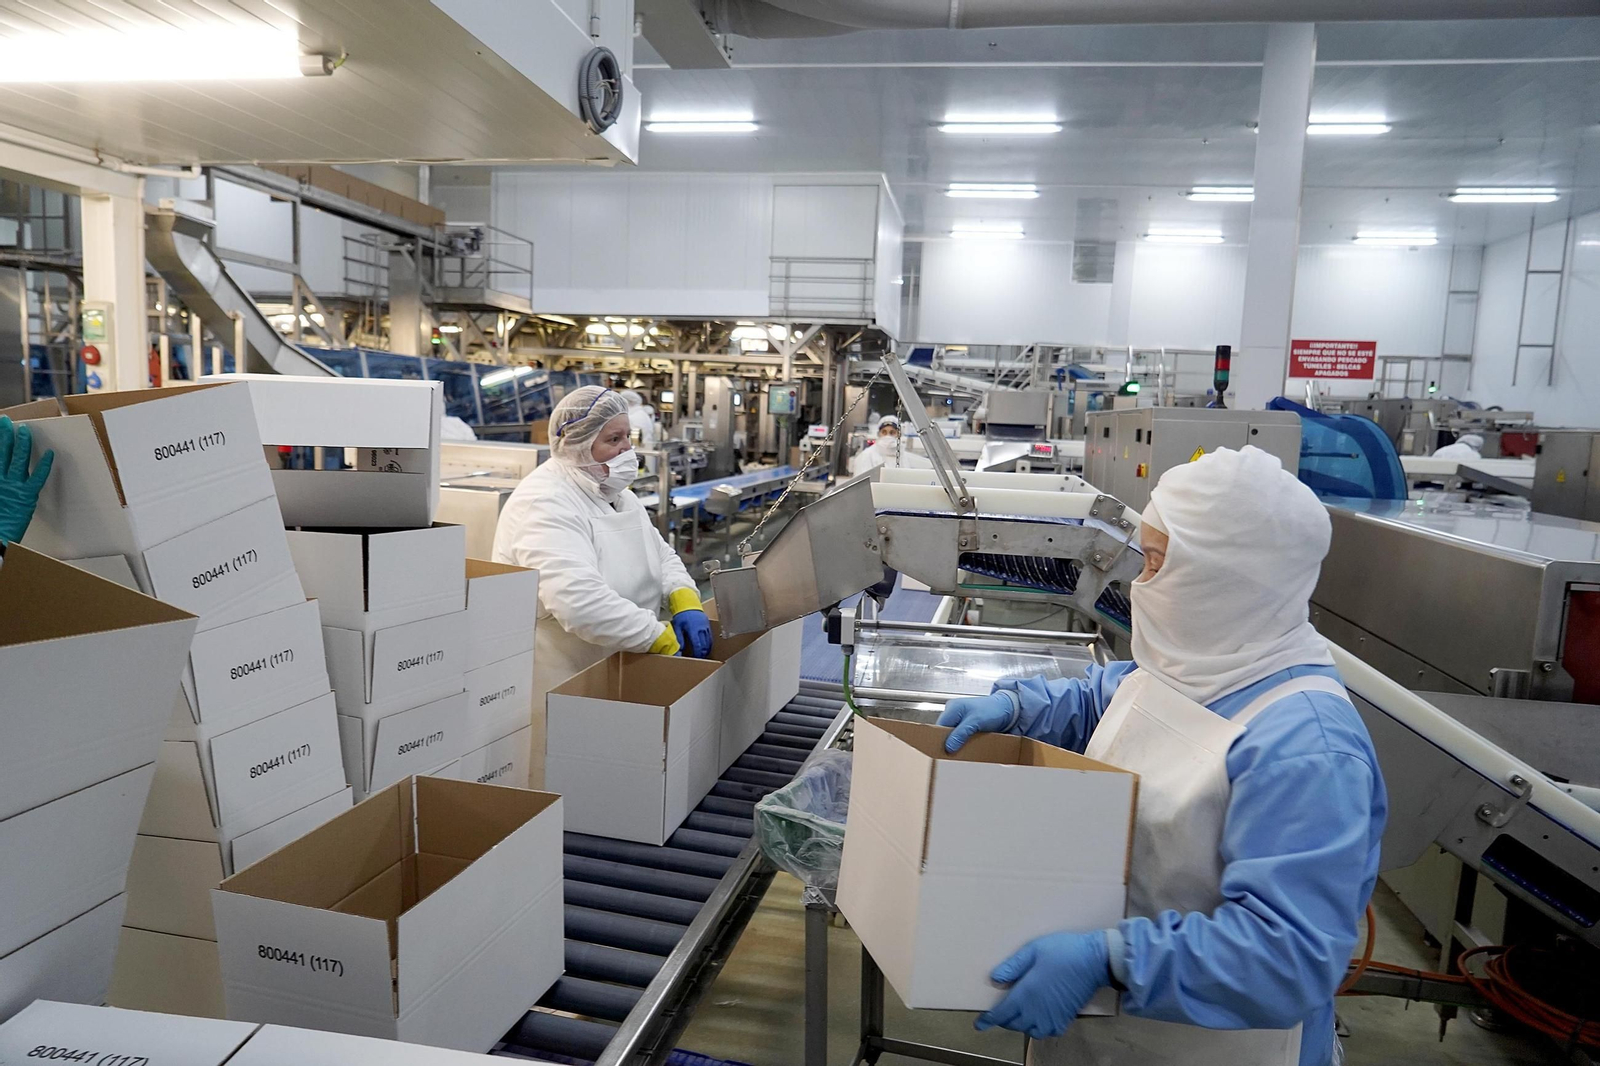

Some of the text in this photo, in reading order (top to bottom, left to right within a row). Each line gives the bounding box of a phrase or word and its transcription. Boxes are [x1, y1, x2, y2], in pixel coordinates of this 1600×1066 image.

[154, 431, 226, 461] 800441 (117)
[192, 549, 258, 589] 800441 (117)
[230, 649, 294, 680] 800441 (117)
[397, 650, 444, 672] 800441 (117)
[479, 685, 516, 707] 800441 (117)
[397, 731, 444, 756] 800441 (117)
[249, 744, 311, 779] 800441 (117)
[499, 762, 513, 777] (117)
[257, 944, 344, 977] 800441 (117)
[27, 1045, 99, 1064] 800441
